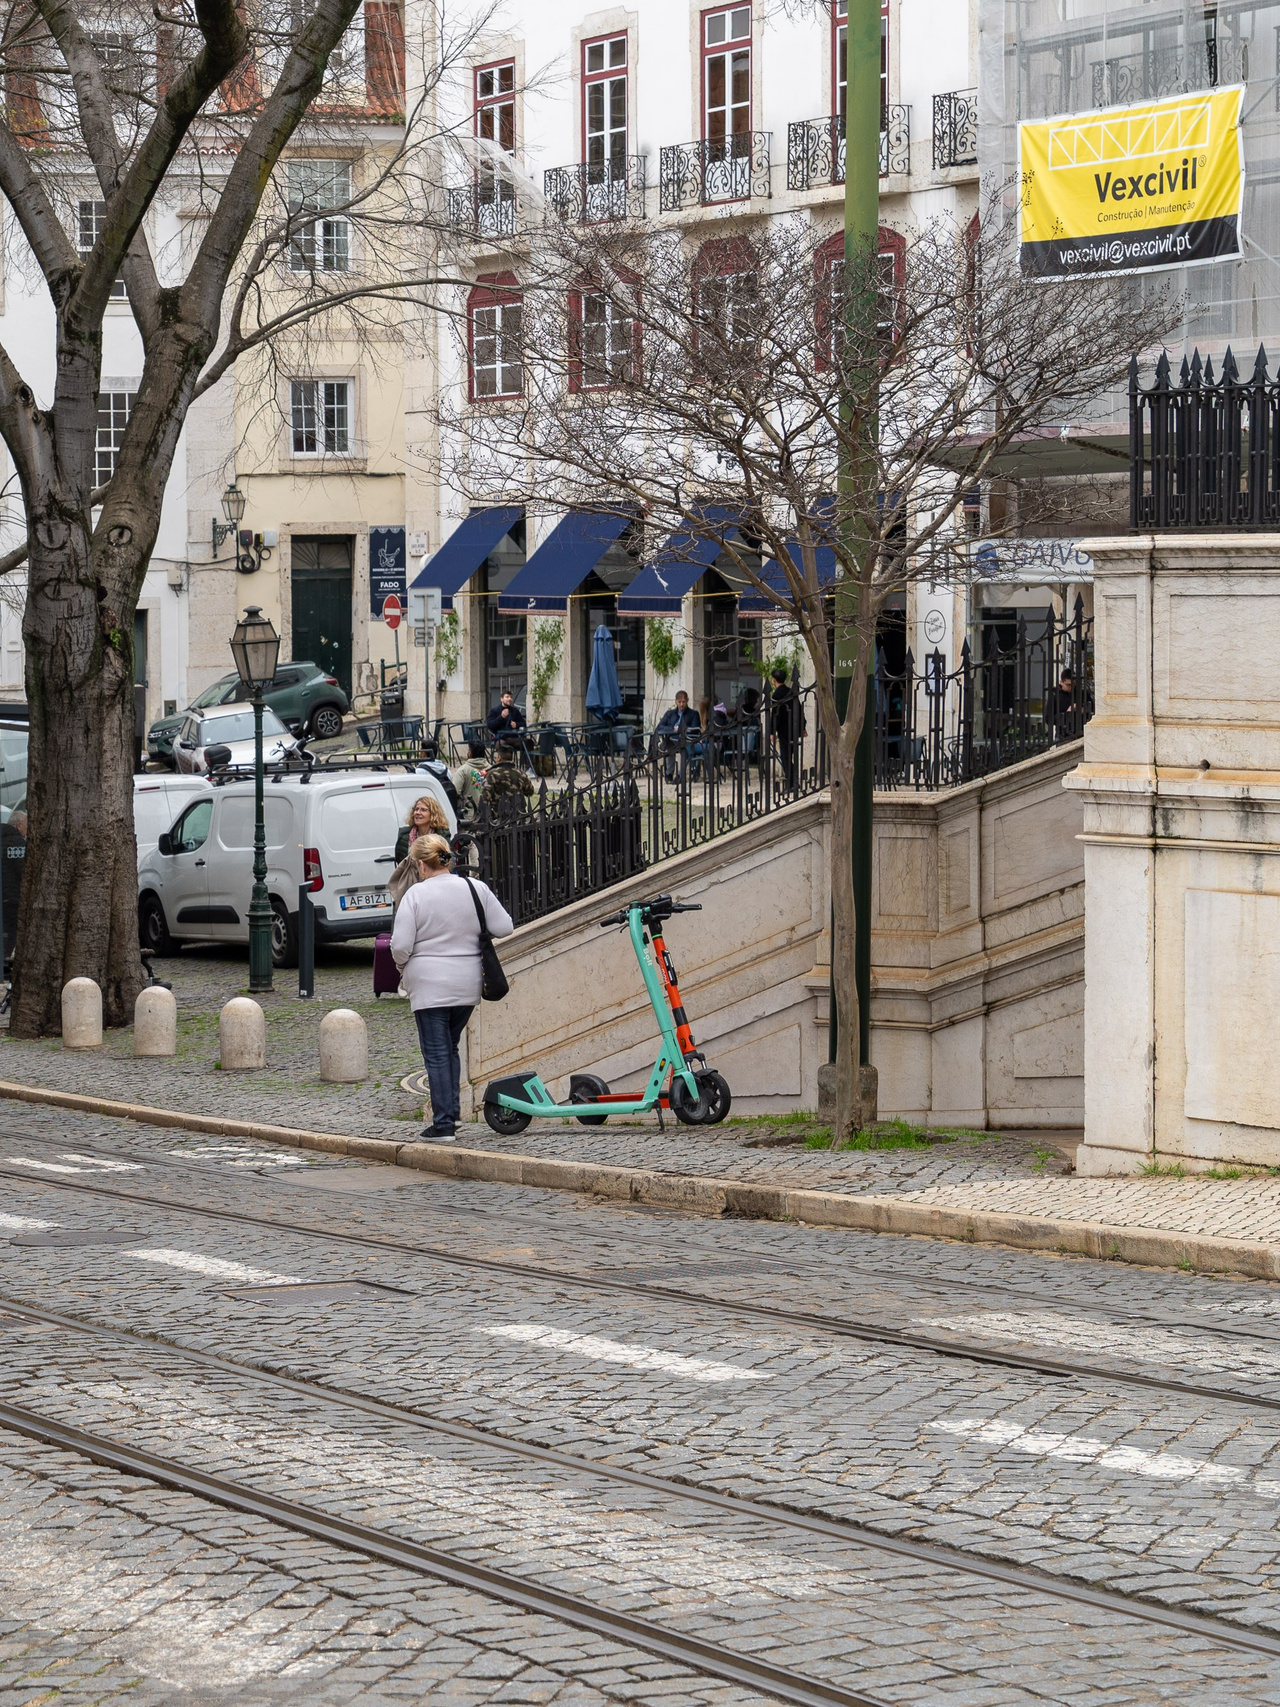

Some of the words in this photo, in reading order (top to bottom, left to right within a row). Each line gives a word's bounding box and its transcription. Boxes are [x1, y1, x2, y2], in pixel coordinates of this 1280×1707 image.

[1097, 204, 1144, 223] Construção
[1148, 201, 1196, 217] Manutenção
[1059, 231, 1192, 265] vexcivil@vexcivil.pt
[838, 658, 857, 668] 164
[642, 947, 653, 967] Bolt
